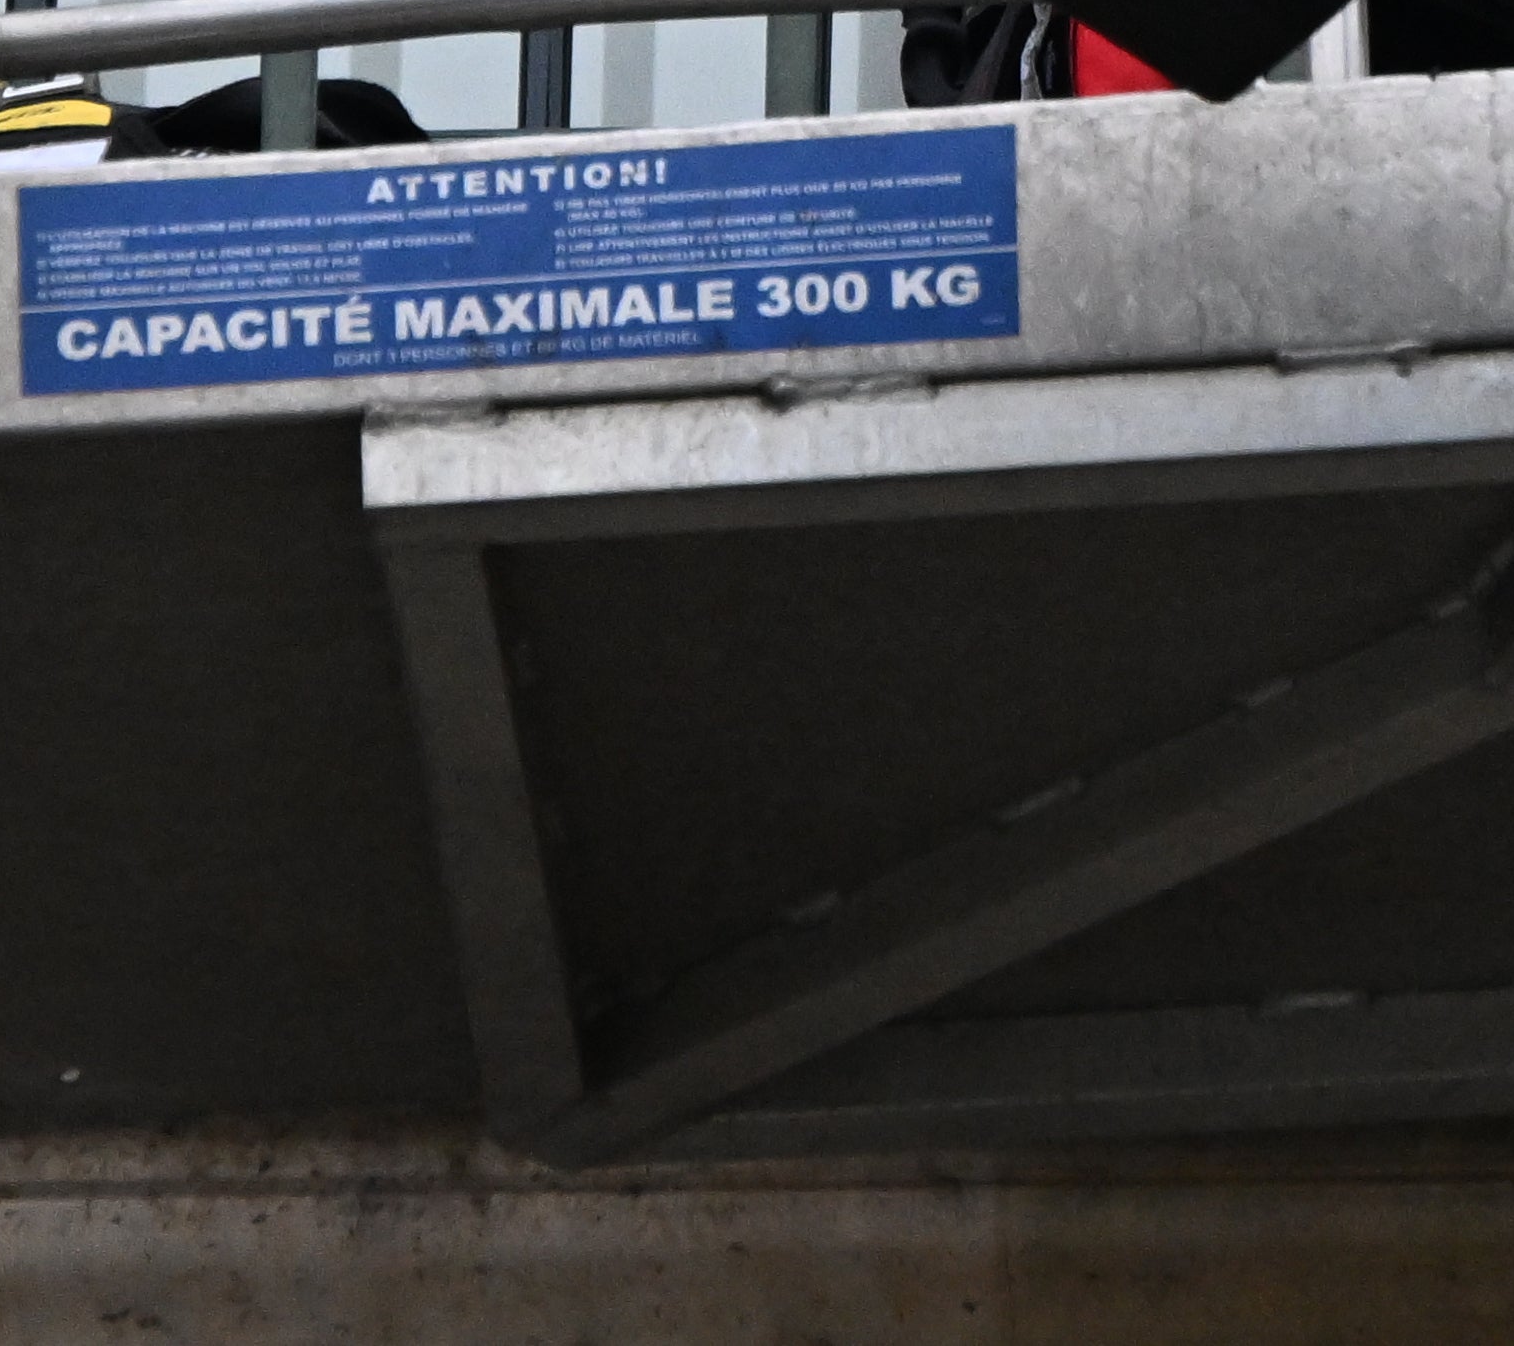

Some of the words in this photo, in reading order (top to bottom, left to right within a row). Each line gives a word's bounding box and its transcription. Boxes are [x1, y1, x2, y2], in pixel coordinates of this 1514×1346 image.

[366, 158, 668, 204] ATTENTION!
[56, 297, 374, 363] CAPACITÉ
[394, 268, 736, 343] MAXIMALE
[756, 270, 869, 320] 300
[891, 262, 983, 312] KG
